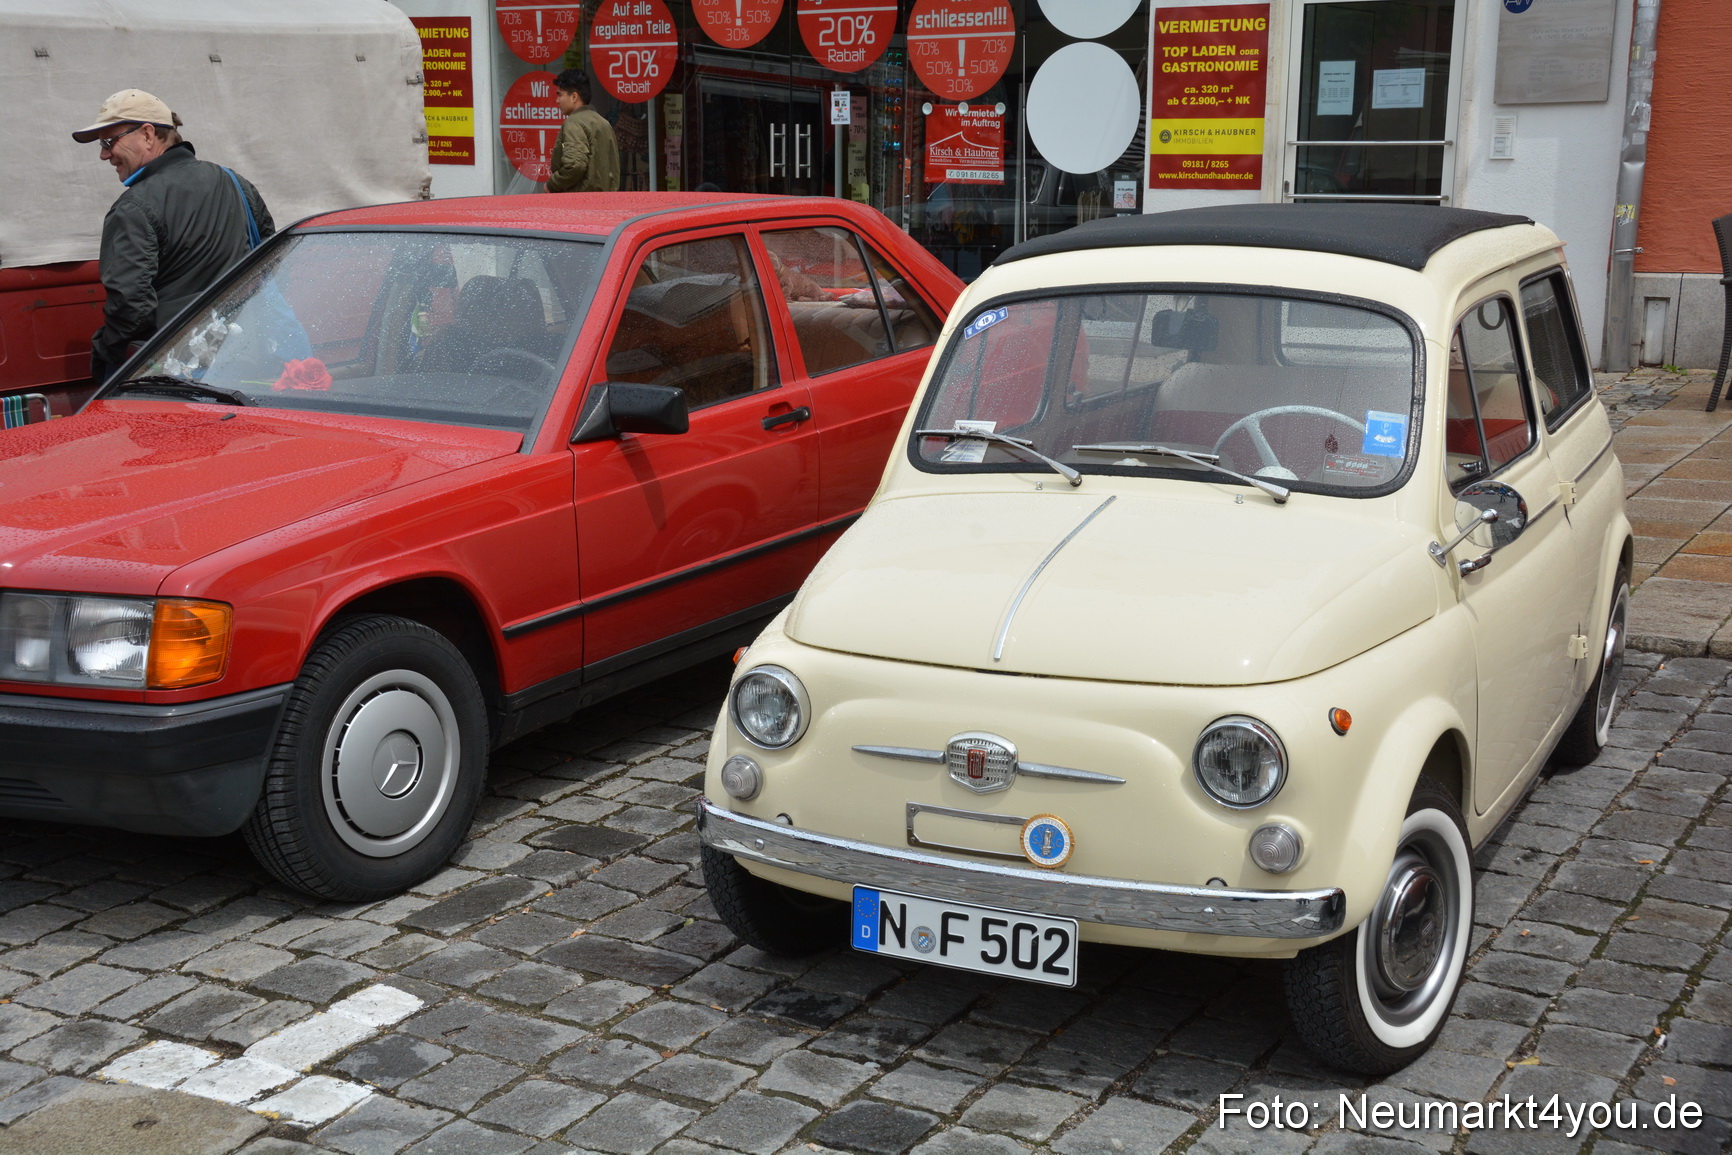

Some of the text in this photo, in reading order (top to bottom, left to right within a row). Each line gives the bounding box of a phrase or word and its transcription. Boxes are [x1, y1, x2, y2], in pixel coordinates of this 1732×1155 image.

[612, 1, 652, 16] Auf alle
[502, 12, 522, 24] 70%
[554, 11, 574, 23] 70%
[708, 11, 731, 24] 50%
[746, 10, 771, 23] 50%
[916, 6, 1007, 28] schliessen!!!
[596, 20, 671, 39] regulären Teile
[819, 15, 876, 46] 20%
[1158, 18, 1266, 34] VERMIETUNG
[416, 27, 469, 38] MIETUNG
[512, 30, 533, 42] 50%
[546, 29, 568, 41] 50%
[725, 28, 749, 41] 30%
[528, 46, 550, 58] 30%
[915, 41, 939, 55] 70%
[982, 39, 1007, 53] 70%
[1162, 46, 1189, 57] TOP
[1192, 45, 1236, 57] LADEN
[422, 49, 451, 58] LADEN
[828, 48, 866, 62] Rabatt
[422, 61, 466, 70] TRONOMIE
[609, 50, 659, 78] 20%
[926, 61, 953, 75] 50%
[970, 60, 998, 74] 50%
[1162, 60, 1259, 73] GASTRONOMIE
[531, 81, 549, 97] Wir
[617, 81, 651, 93] Rabatt
[946, 79, 974, 92] 30%
[1201, 85, 1218, 93] 320
[1221, 85, 1233, 93] m²
[1167, 97, 1179, 105] ab
[1182, 97, 1188, 105] €
[1236, 96, 1250, 104] NK
[506, 103, 569, 119] schliessen
[972, 119, 1000, 129] Auftrag
[506, 131, 525, 143] 70%
[515, 148, 536, 160] 50%
[930, 147, 998, 157] Kirsch & Haubner
[1182, 160, 1229, 169] 09181 / 8265
[1159, 171, 1253, 180] www.kirschundhaubner.de
[1032, 836, 1062, 848] S C
[862, 926, 871, 938] D
[879, 900, 906, 948] N
[940, 911, 969, 956] F
[981, 917, 1069, 976] 502
